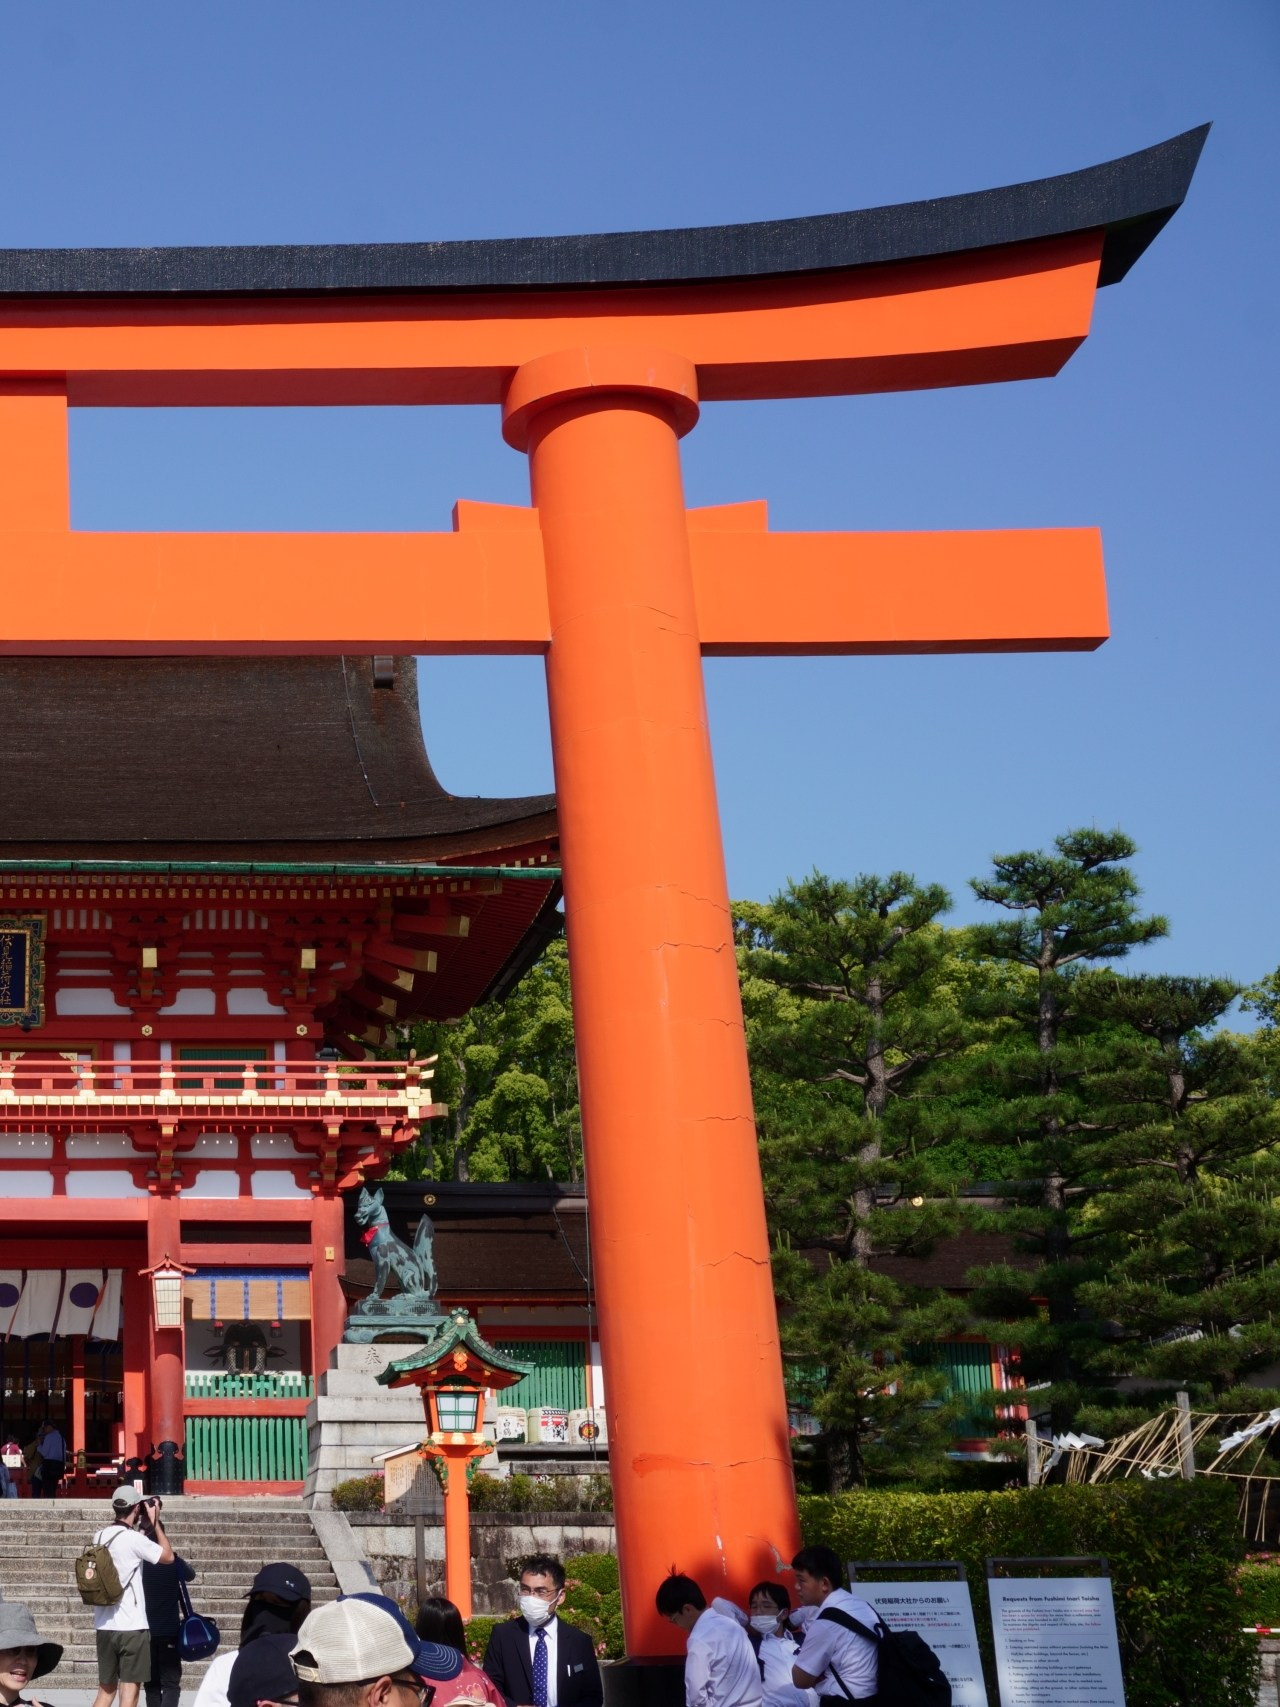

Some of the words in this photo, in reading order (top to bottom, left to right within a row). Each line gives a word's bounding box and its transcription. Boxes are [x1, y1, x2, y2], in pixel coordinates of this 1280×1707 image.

[0, 934, 14, 1006] 伏見稲荷大社
[875, 1597, 950, 1605] 伏見稲荷大社からのお願い
